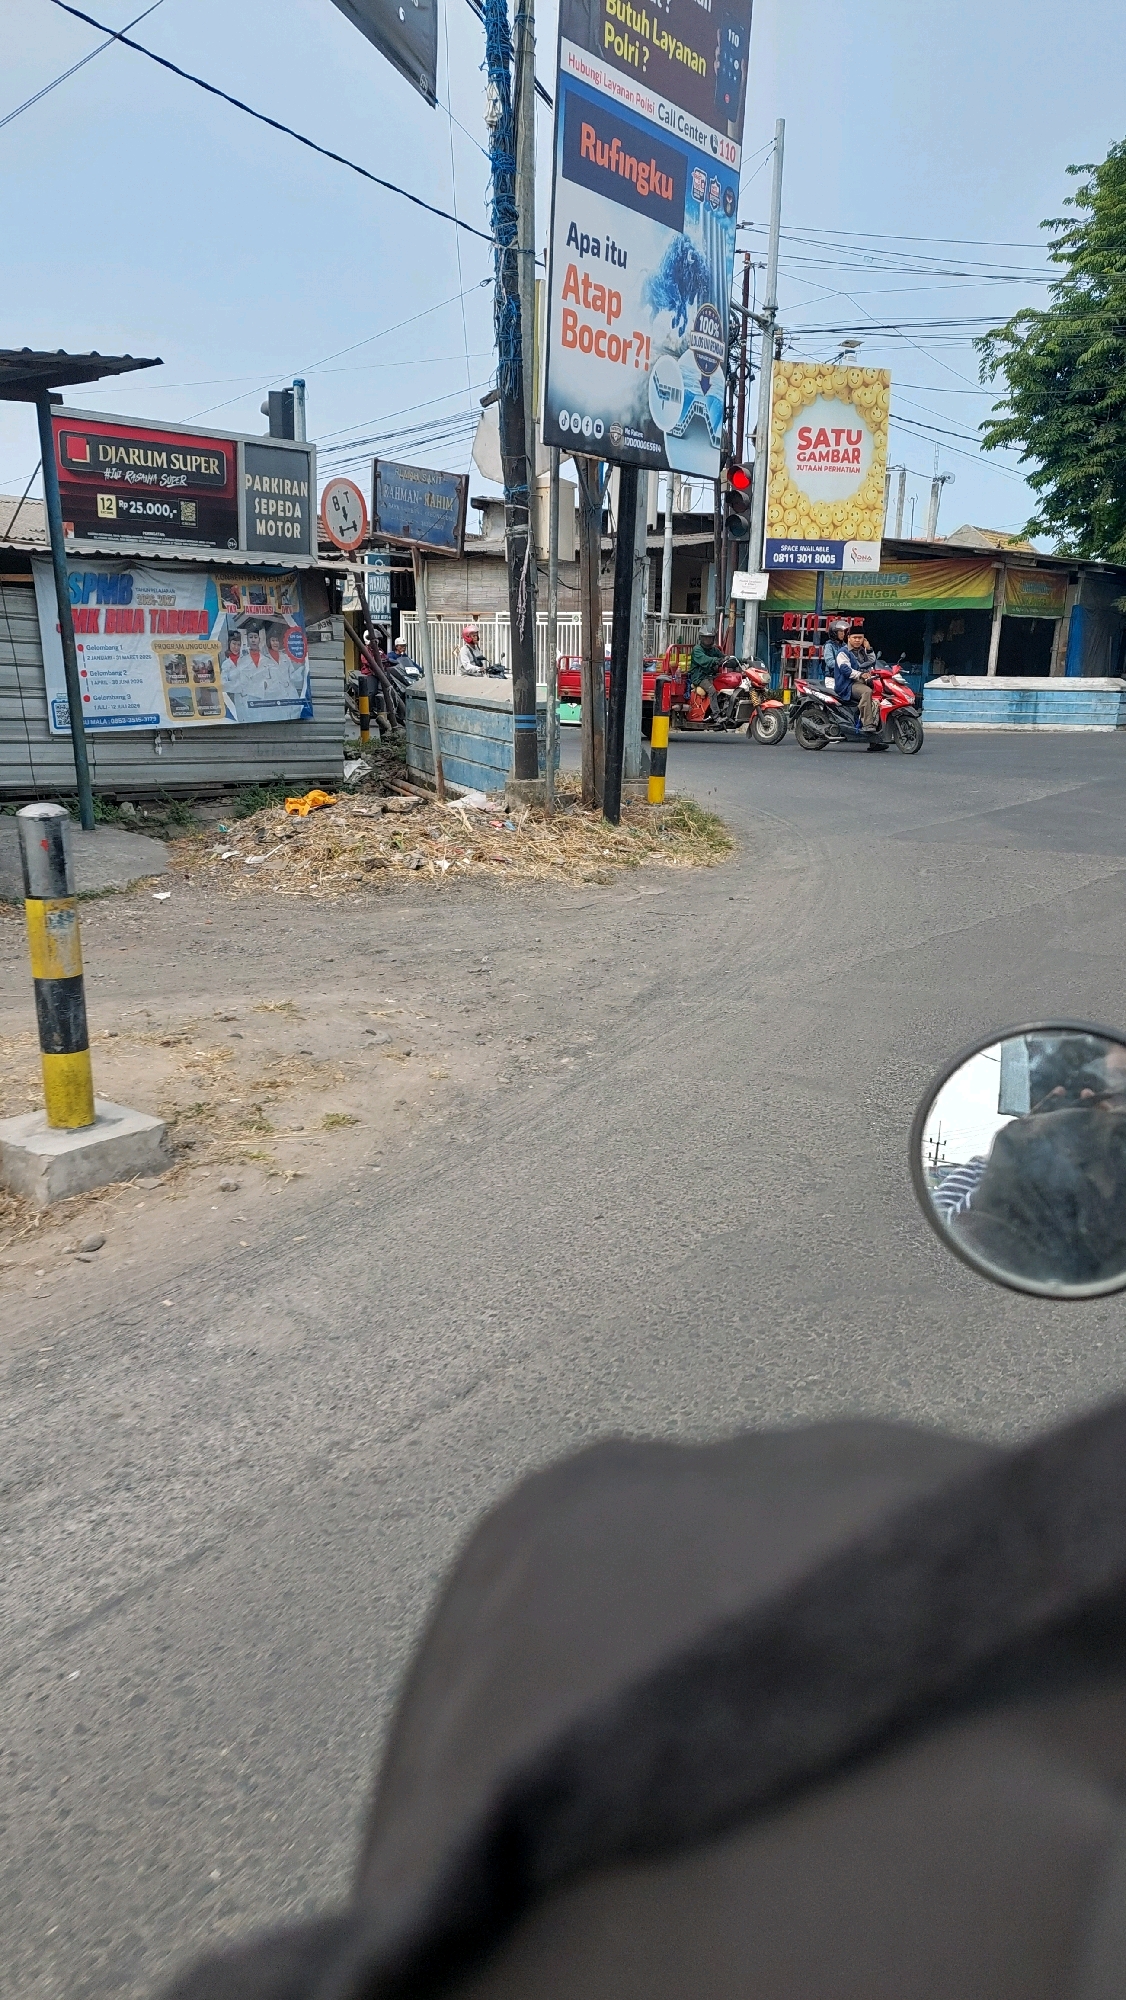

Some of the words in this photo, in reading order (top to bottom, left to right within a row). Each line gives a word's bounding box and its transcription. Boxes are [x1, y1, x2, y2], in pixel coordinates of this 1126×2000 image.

[604, 20, 640, 67] Polri
[605, 0, 650, 39] Butuh
[652, 17, 707, 77] Layanan
[728, 28, 740, 48] 110
[568, 52, 603, 85] Hubungi
[603, 73, 634, 102] Layanan
[635, 92, 655, 115] Polisi
[658, 102, 676, 129] Call
[678, 115, 708, 146] Center
[719, 138, 736, 164] 110
[580, 121, 673, 201] Rufingku
[566, 221, 601, 258] Apa
[604, 235, 628, 270] itu
[561, 263, 622, 326] Atap
[699, 315, 720, 338] 100%
[561, 307, 651, 372] Bocor?!
[797, 427, 863, 450] SATU
[98, 444, 168, 469] DJARUM
[170, 453, 220, 475] SUPER
[796, 447, 861, 464] GAMBAR
[796, 464, 822, 472] JUTAAN
[824, 464, 861, 474] PERHATIAN
[245, 473, 309, 497] PARKIRAN
[99, 497, 114, 511] 12
[118, 499, 129, 510] Rp
[129, 500, 178, 519] 25.000,-
[254, 497, 302, 519] SEPEDA
[343, 491, 350, 504] T
[256, 519, 301, 539] MOTOR
[773, 553, 794, 563] 0811
[796, 553, 812, 563] 301
[814, 554, 836, 564] 8005
[68, 571, 134, 605] SPMB
[827, 571, 911, 588] WARMINDO
[369, 594, 392, 614] KOPI
[831, 590, 852, 599] WK
[853, 589, 898, 599] JINGGA
[104, 609, 145, 633] BINA
[149, 610, 209, 634] TARUNA
